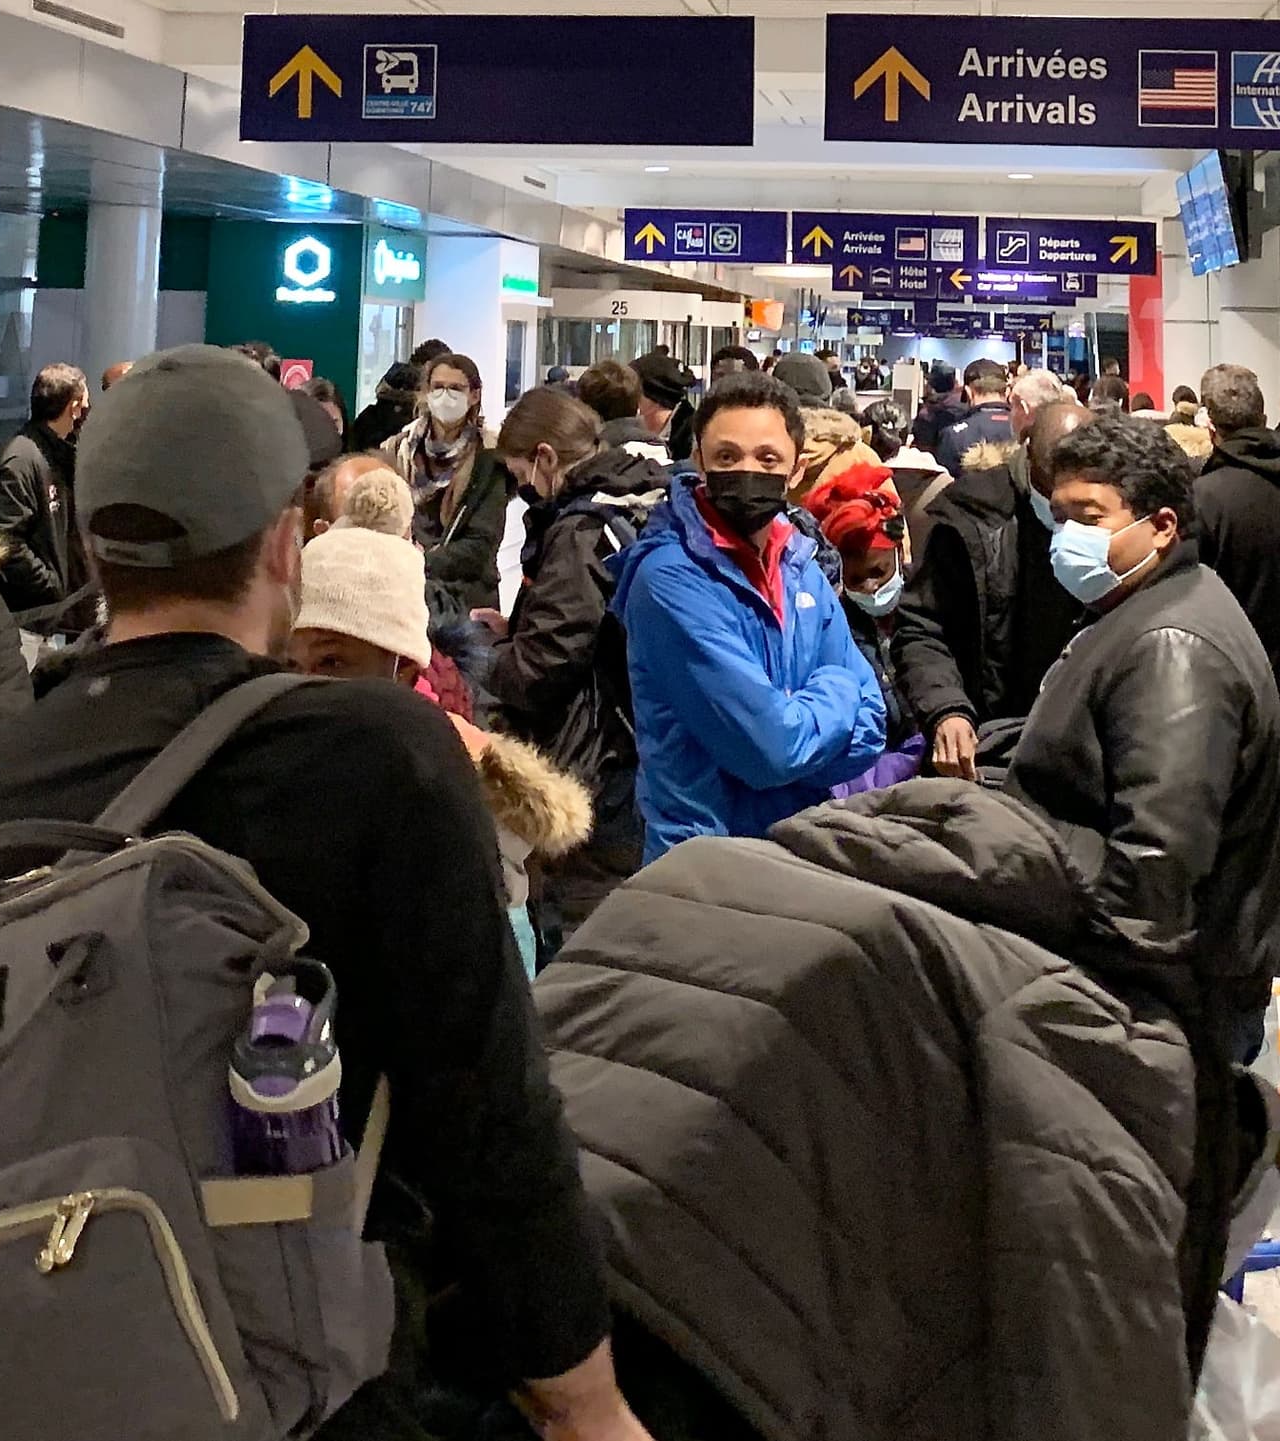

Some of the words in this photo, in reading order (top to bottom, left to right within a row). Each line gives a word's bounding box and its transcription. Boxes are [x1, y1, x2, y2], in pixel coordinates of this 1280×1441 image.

[958, 48, 1108, 80] Arrivées
[410, 101, 432, 114] 747
[958, 93, 1097, 126] Arrivals
[843, 231, 885, 242] Arrivées
[843, 244, 882, 254] Arrivals
[1039, 237, 1080, 249] Départs
[1039, 250, 1097, 262] Departures
[900, 265, 927, 277] Hôtel
[900, 279, 927, 290] Hotel
[611, 300, 628, 316] 25
